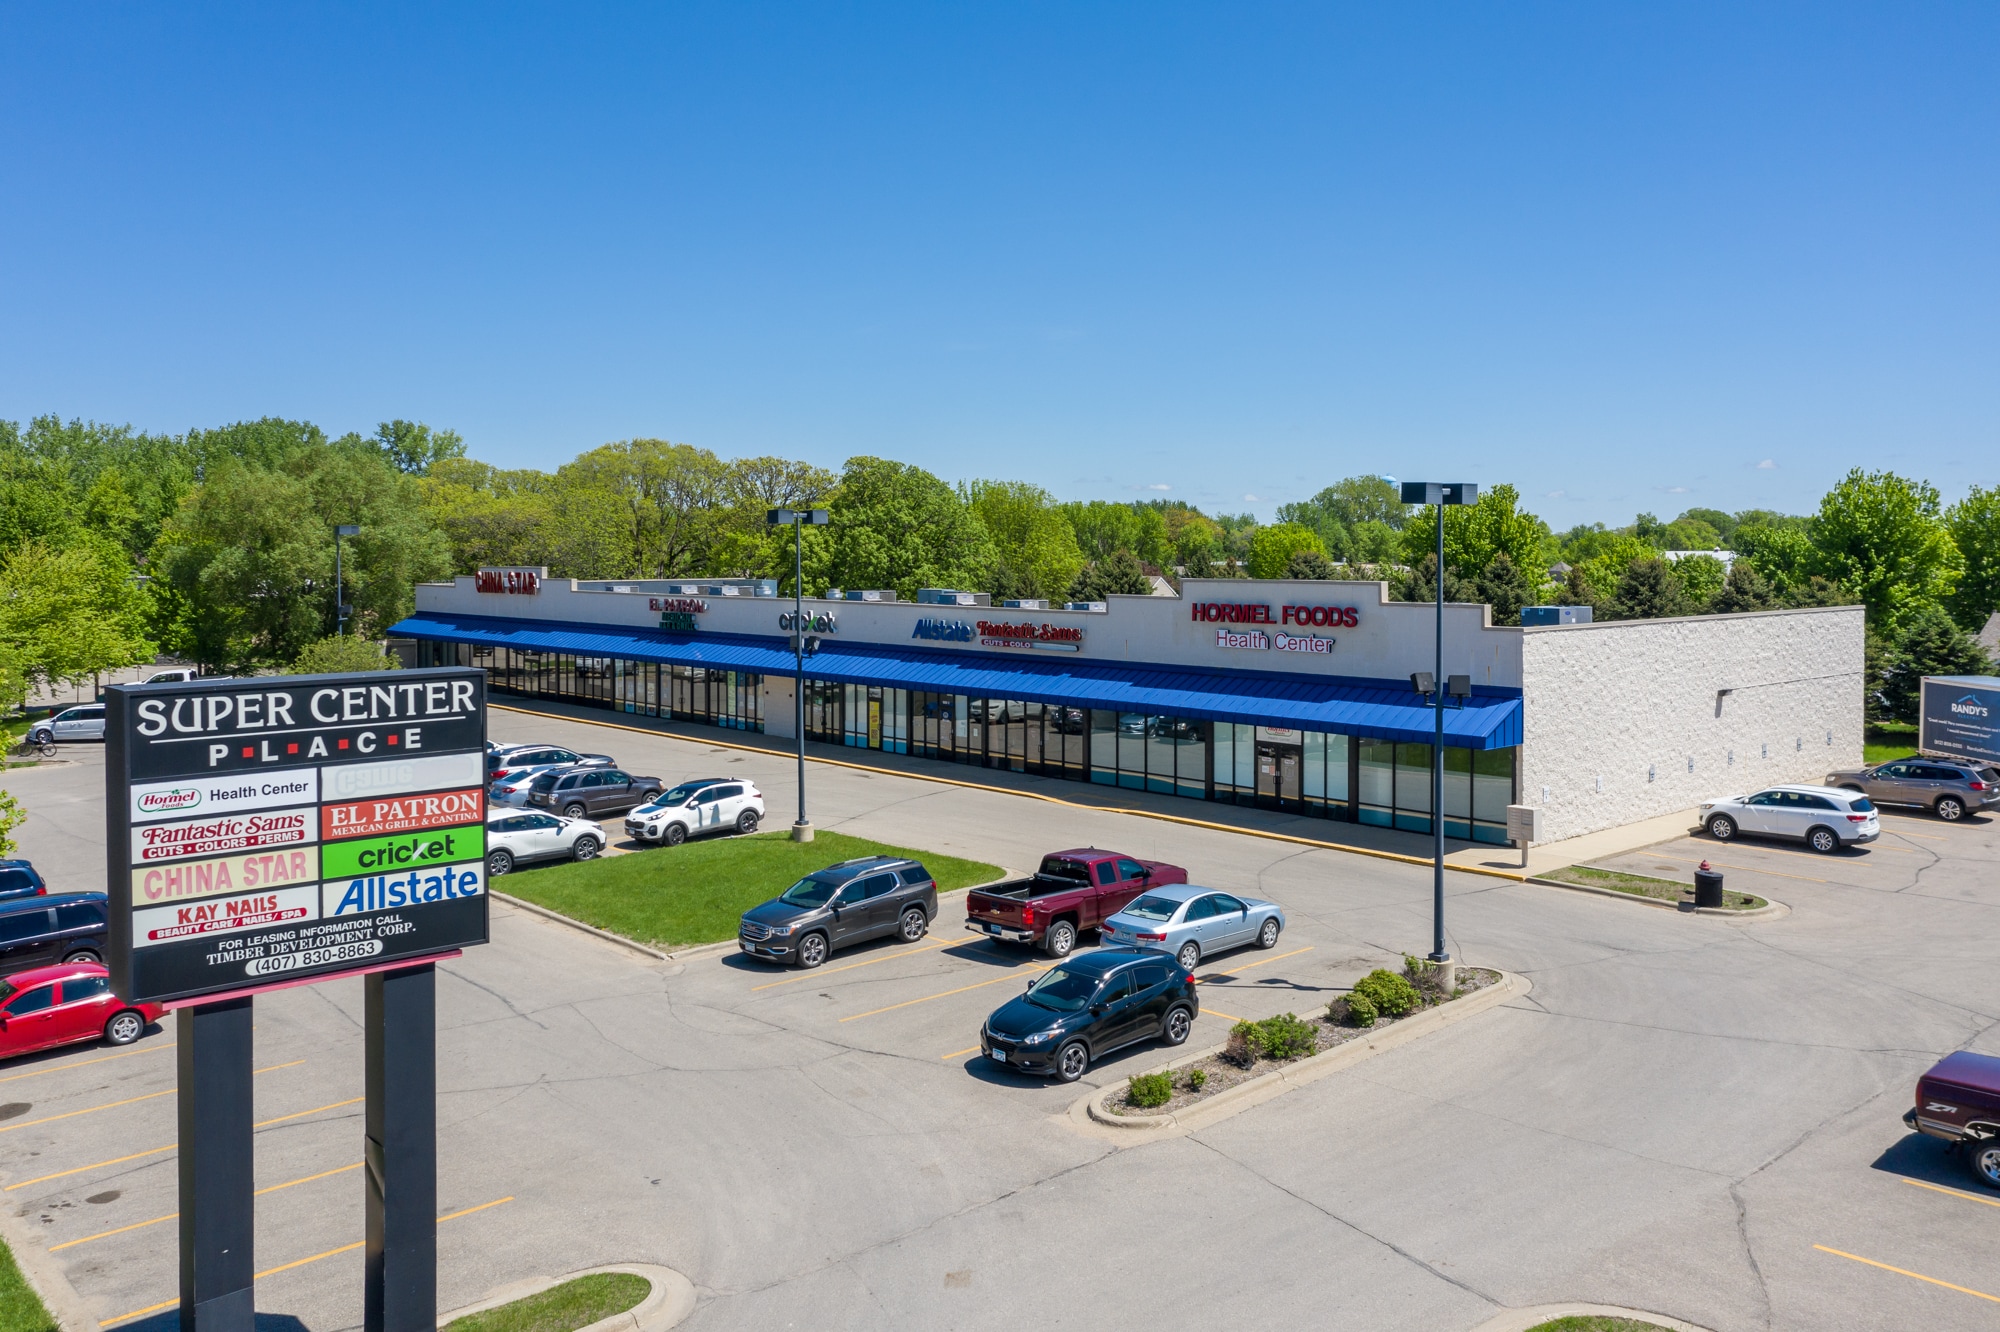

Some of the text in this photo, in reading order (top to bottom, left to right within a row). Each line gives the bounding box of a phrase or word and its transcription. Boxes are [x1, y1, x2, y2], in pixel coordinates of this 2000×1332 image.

[475, 571, 537, 595] CHINA STAR
[649, 598, 705, 613] EL PATRON
[1191, 603, 1358, 628] HORMEL FOODS
[912, 618, 971, 642] Allstate
[976, 620, 1083, 642] Fantastic Sams
[1216, 629, 1335, 653] Health Center
[136, 680, 476, 736] SUPER CENTER
[1951, 703, 1988, 717] RANDY'S
[144, 791, 195, 806] Hormel
[210, 782, 308, 802] Health Center
[330, 792, 479, 827] EL PATRON
[332, 812, 478, 836] MEXICAN GRILL & CANTINA
[142, 814, 305, 846] Fantastic Sams
[148, 830, 300, 858] CUTS COLORS PERMS
[358, 834, 455, 868] cricket
[144, 851, 306, 900] CHINA STAR
[334, 867, 478, 916] Allstate
[156, 909, 302, 939] BEAUTY CARE/ NAILS/ SPA
[177, 894, 278, 925] KAY NAILS
[206, 922, 416, 966] TIMBER DEVELOPMENT CORP.
[218, 914, 402, 951] FOR LEASING INFORMATION CALL
[255, 942, 375, 974] (407) 830-8863
